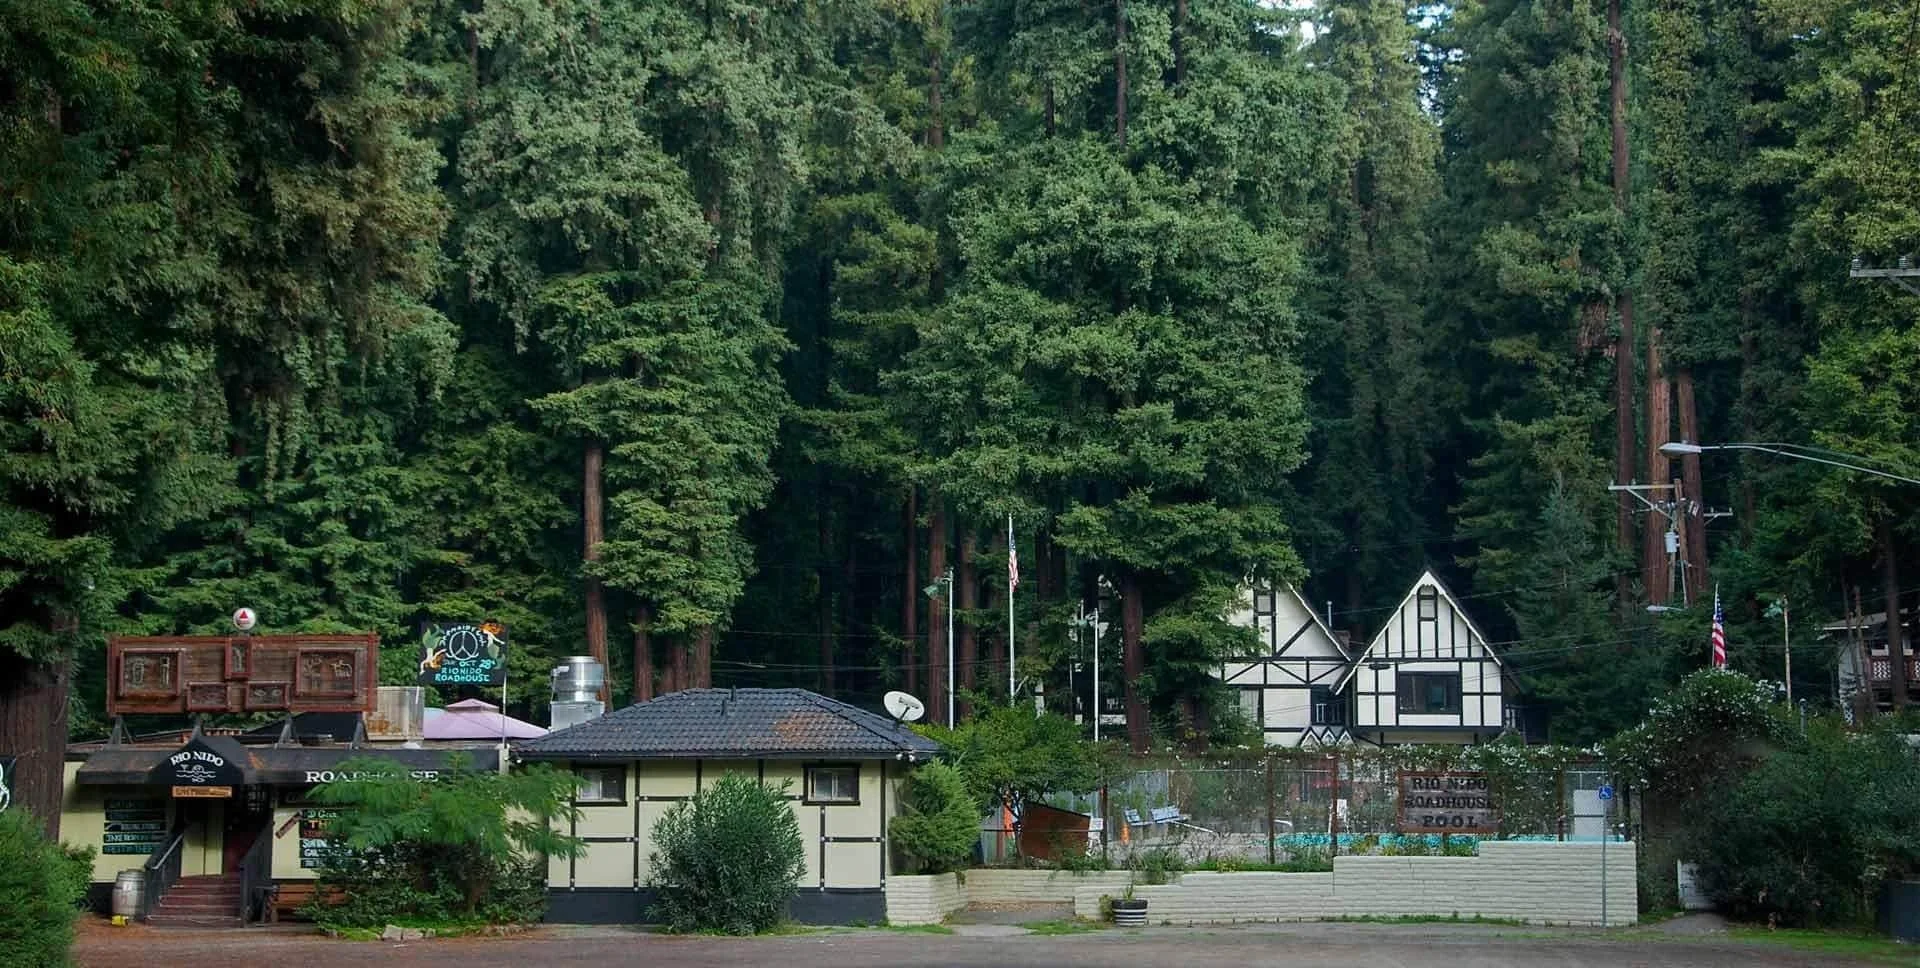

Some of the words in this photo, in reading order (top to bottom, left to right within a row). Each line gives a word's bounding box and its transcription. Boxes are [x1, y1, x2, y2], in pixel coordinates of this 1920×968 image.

[169, 751, 191, 767] RIO
[193, 751, 224, 767] NIDO
[305, 770, 439, 783] ROADHSE
[1412, 777, 1440, 790] RIO
[1422, 815, 1478, 828] POOL
